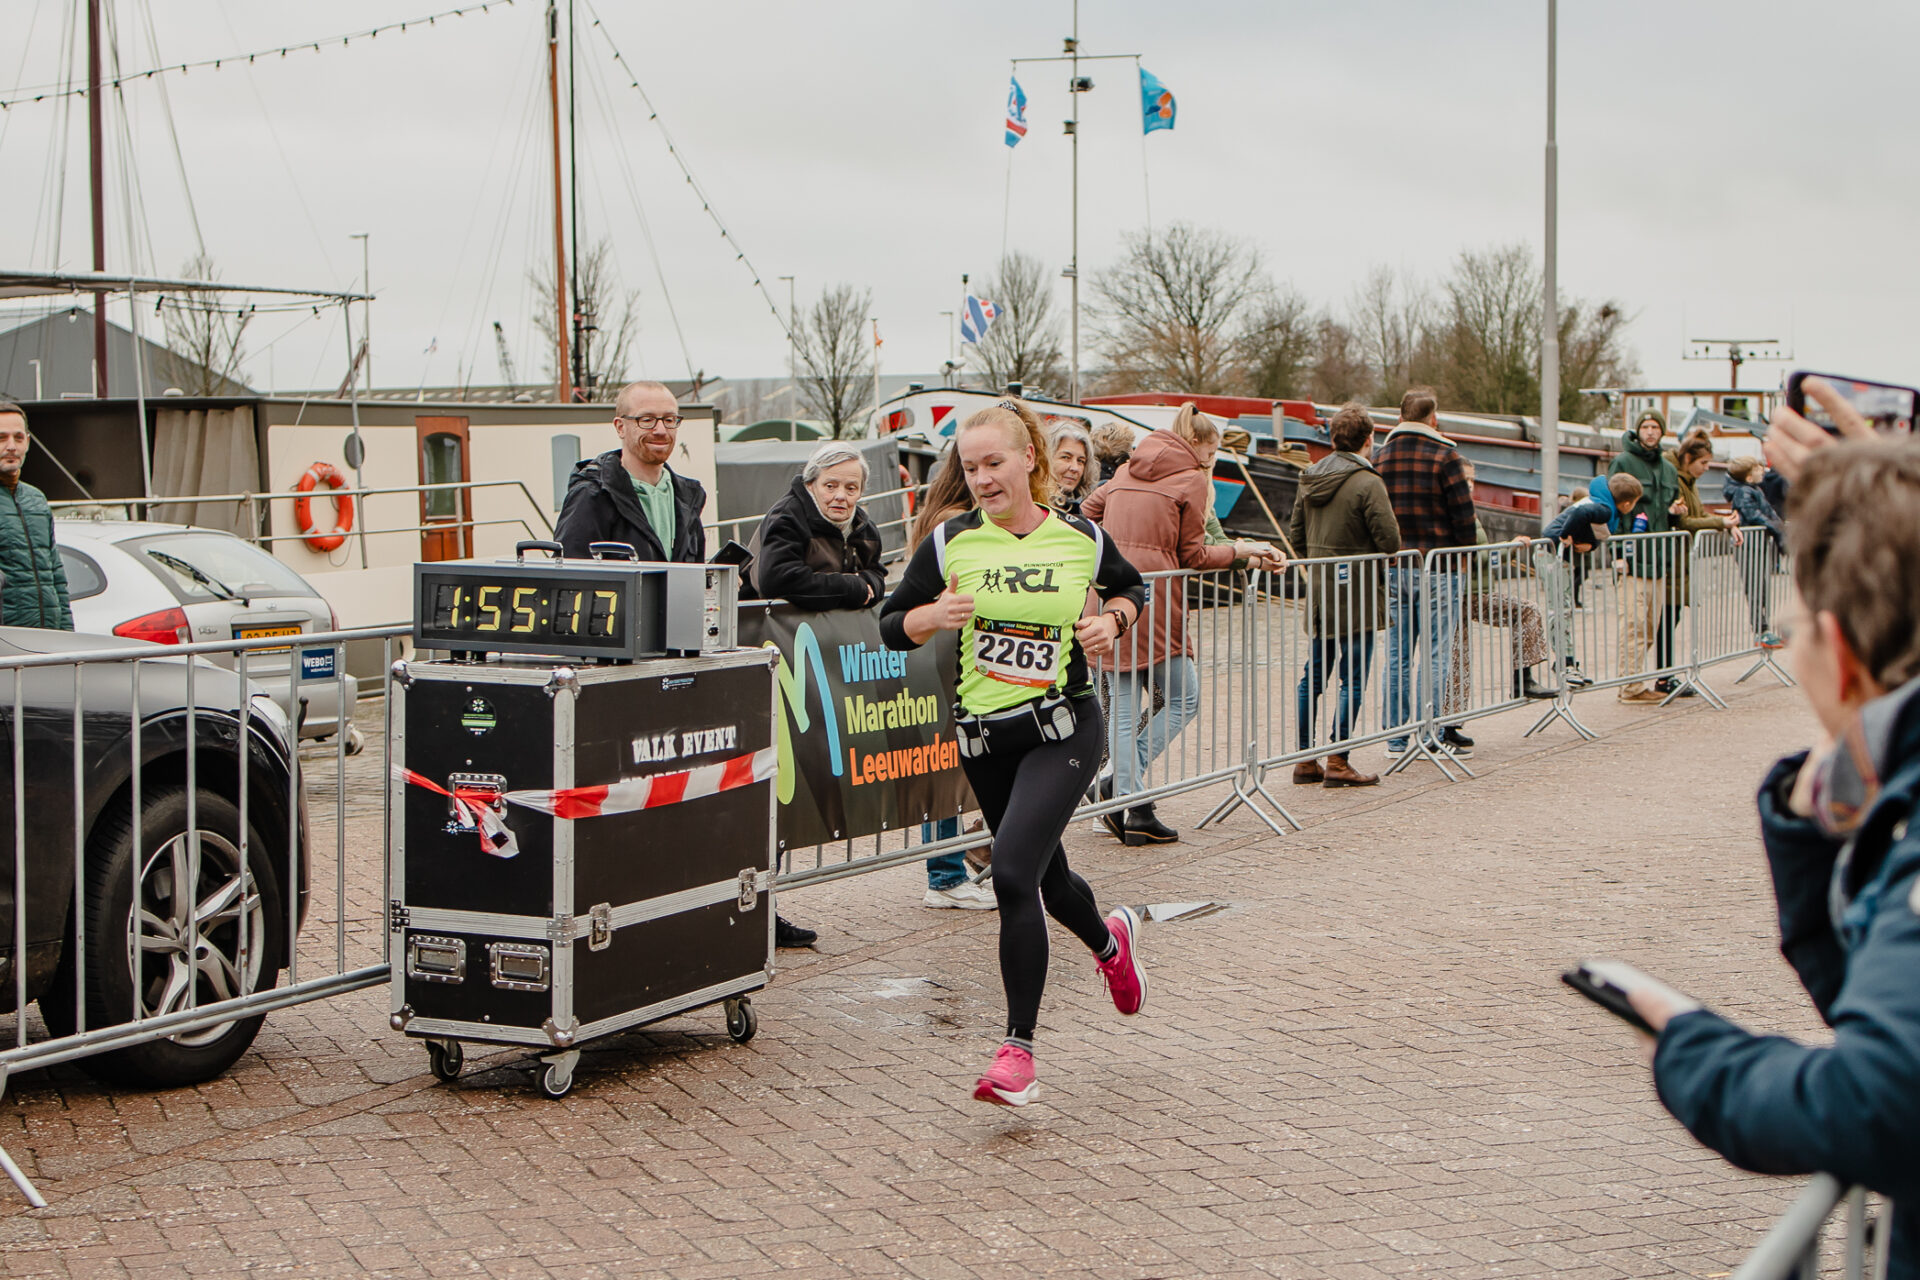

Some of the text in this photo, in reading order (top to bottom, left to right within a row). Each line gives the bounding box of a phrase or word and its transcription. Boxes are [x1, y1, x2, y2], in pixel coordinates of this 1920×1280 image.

[1004, 566, 1059, 593] RCL
[451, 586, 617, 635] 1:55:17
[1016, 623, 1039, 631] Marathon
[303, 656, 325, 668] WEBO
[839, 642, 908, 683] Winter
[978, 635, 1054, 671] 2263
[844, 687, 938, 735] Marathon
[631, 725, 737, 765] VALK EVENT
[849, 732, 959, 786] Leeuwarden
